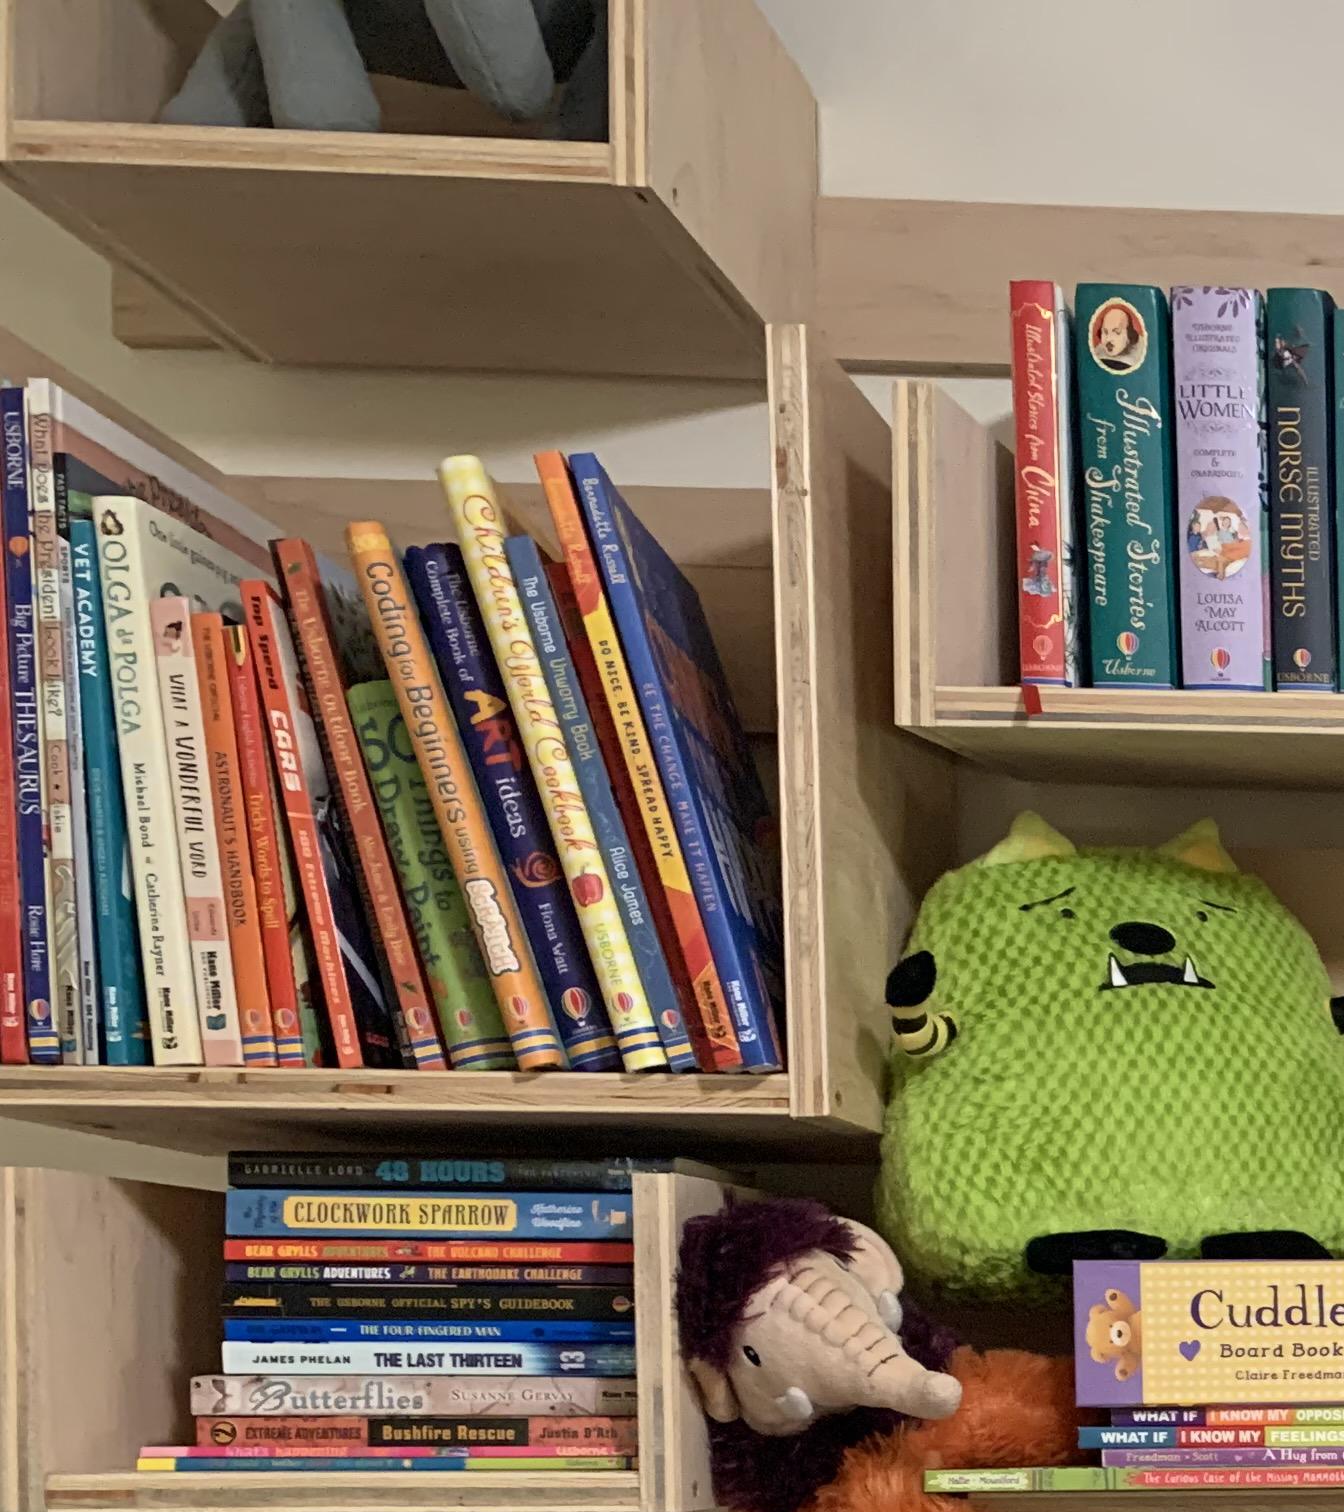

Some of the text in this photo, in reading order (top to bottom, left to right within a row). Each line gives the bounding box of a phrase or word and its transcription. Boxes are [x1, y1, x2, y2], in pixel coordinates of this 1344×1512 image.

[1179, 384, 1252, 401] LITTLE
[1179, 400, 1253, 421] WOMEN
[74, 544, 99, 680] VET ACADEMY
[101, 540, 141, 737] OLGA POLGA
[293, 1202, 509, 1226] CLOCKWORK SPARROW
[1220, 1343, 1284, 1358] Board
[1293, 1342, 1344, 1357] Book
[252, 1355, 351, 1364] JAMES PHELAN
[375, 1353, 522, 1368] THE LAST THIRTEEN
[1235, 1369, 1278, 1379] Claire
[249, 1380, 423, 1411] Butterflies
[383, 1425, 515, 1441] Bushfire Rescue
